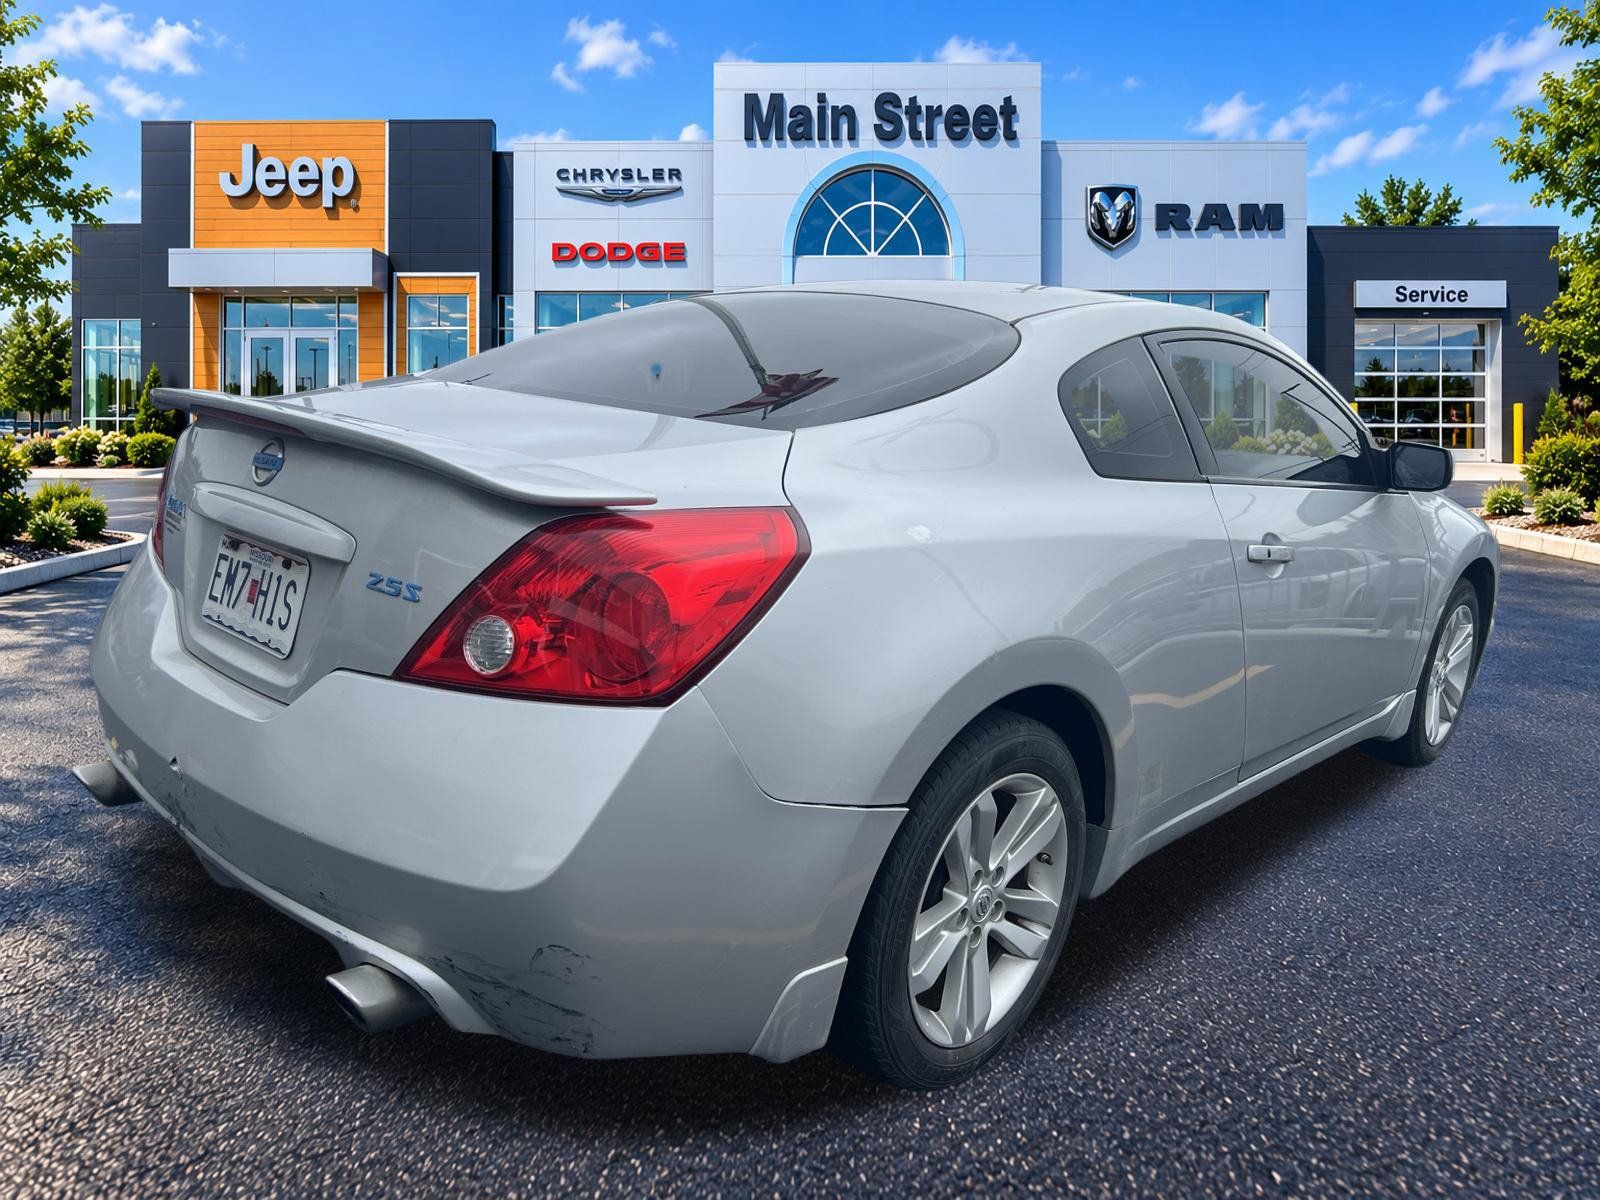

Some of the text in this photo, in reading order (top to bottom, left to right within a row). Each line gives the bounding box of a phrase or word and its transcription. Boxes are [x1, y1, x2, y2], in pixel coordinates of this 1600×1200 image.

[743, 91, 1018, 142] Main Street
[218, 143, 355, 208] Jeep
[555, 167, 683, 184] CHRYSLER
[1155, 203, 1284, 232] RAM
[551, 242, 687, 262] DODGE
[1395, 285, 1469, 303] Service
[208, 552, 252, 610] EM7
